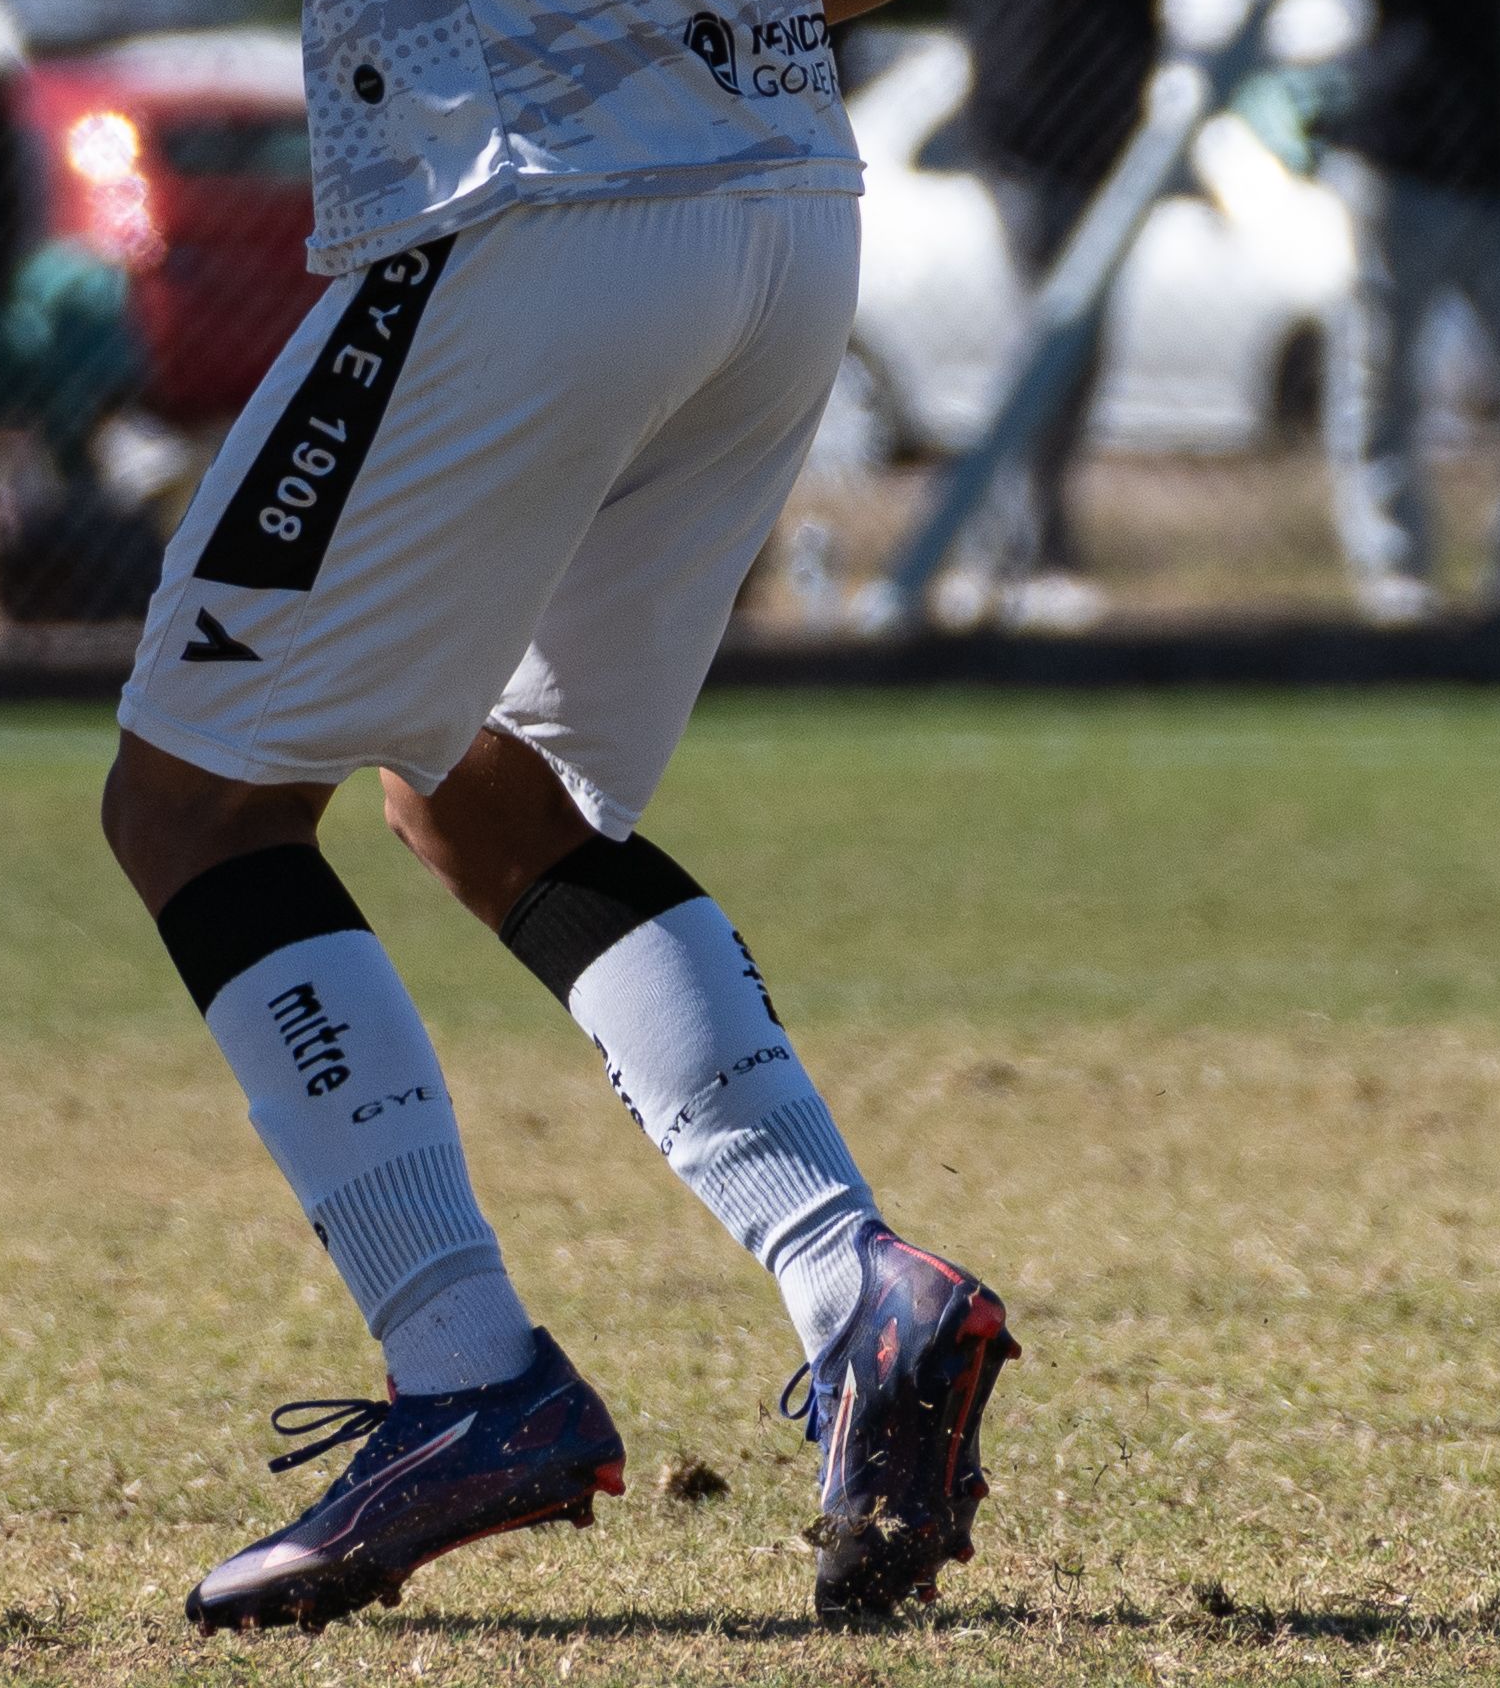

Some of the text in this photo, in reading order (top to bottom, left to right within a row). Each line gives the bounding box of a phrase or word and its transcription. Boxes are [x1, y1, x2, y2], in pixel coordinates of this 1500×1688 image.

[258, 249, 431, 542] GYE 1908
[268, 981, 351, 1098] mitre
